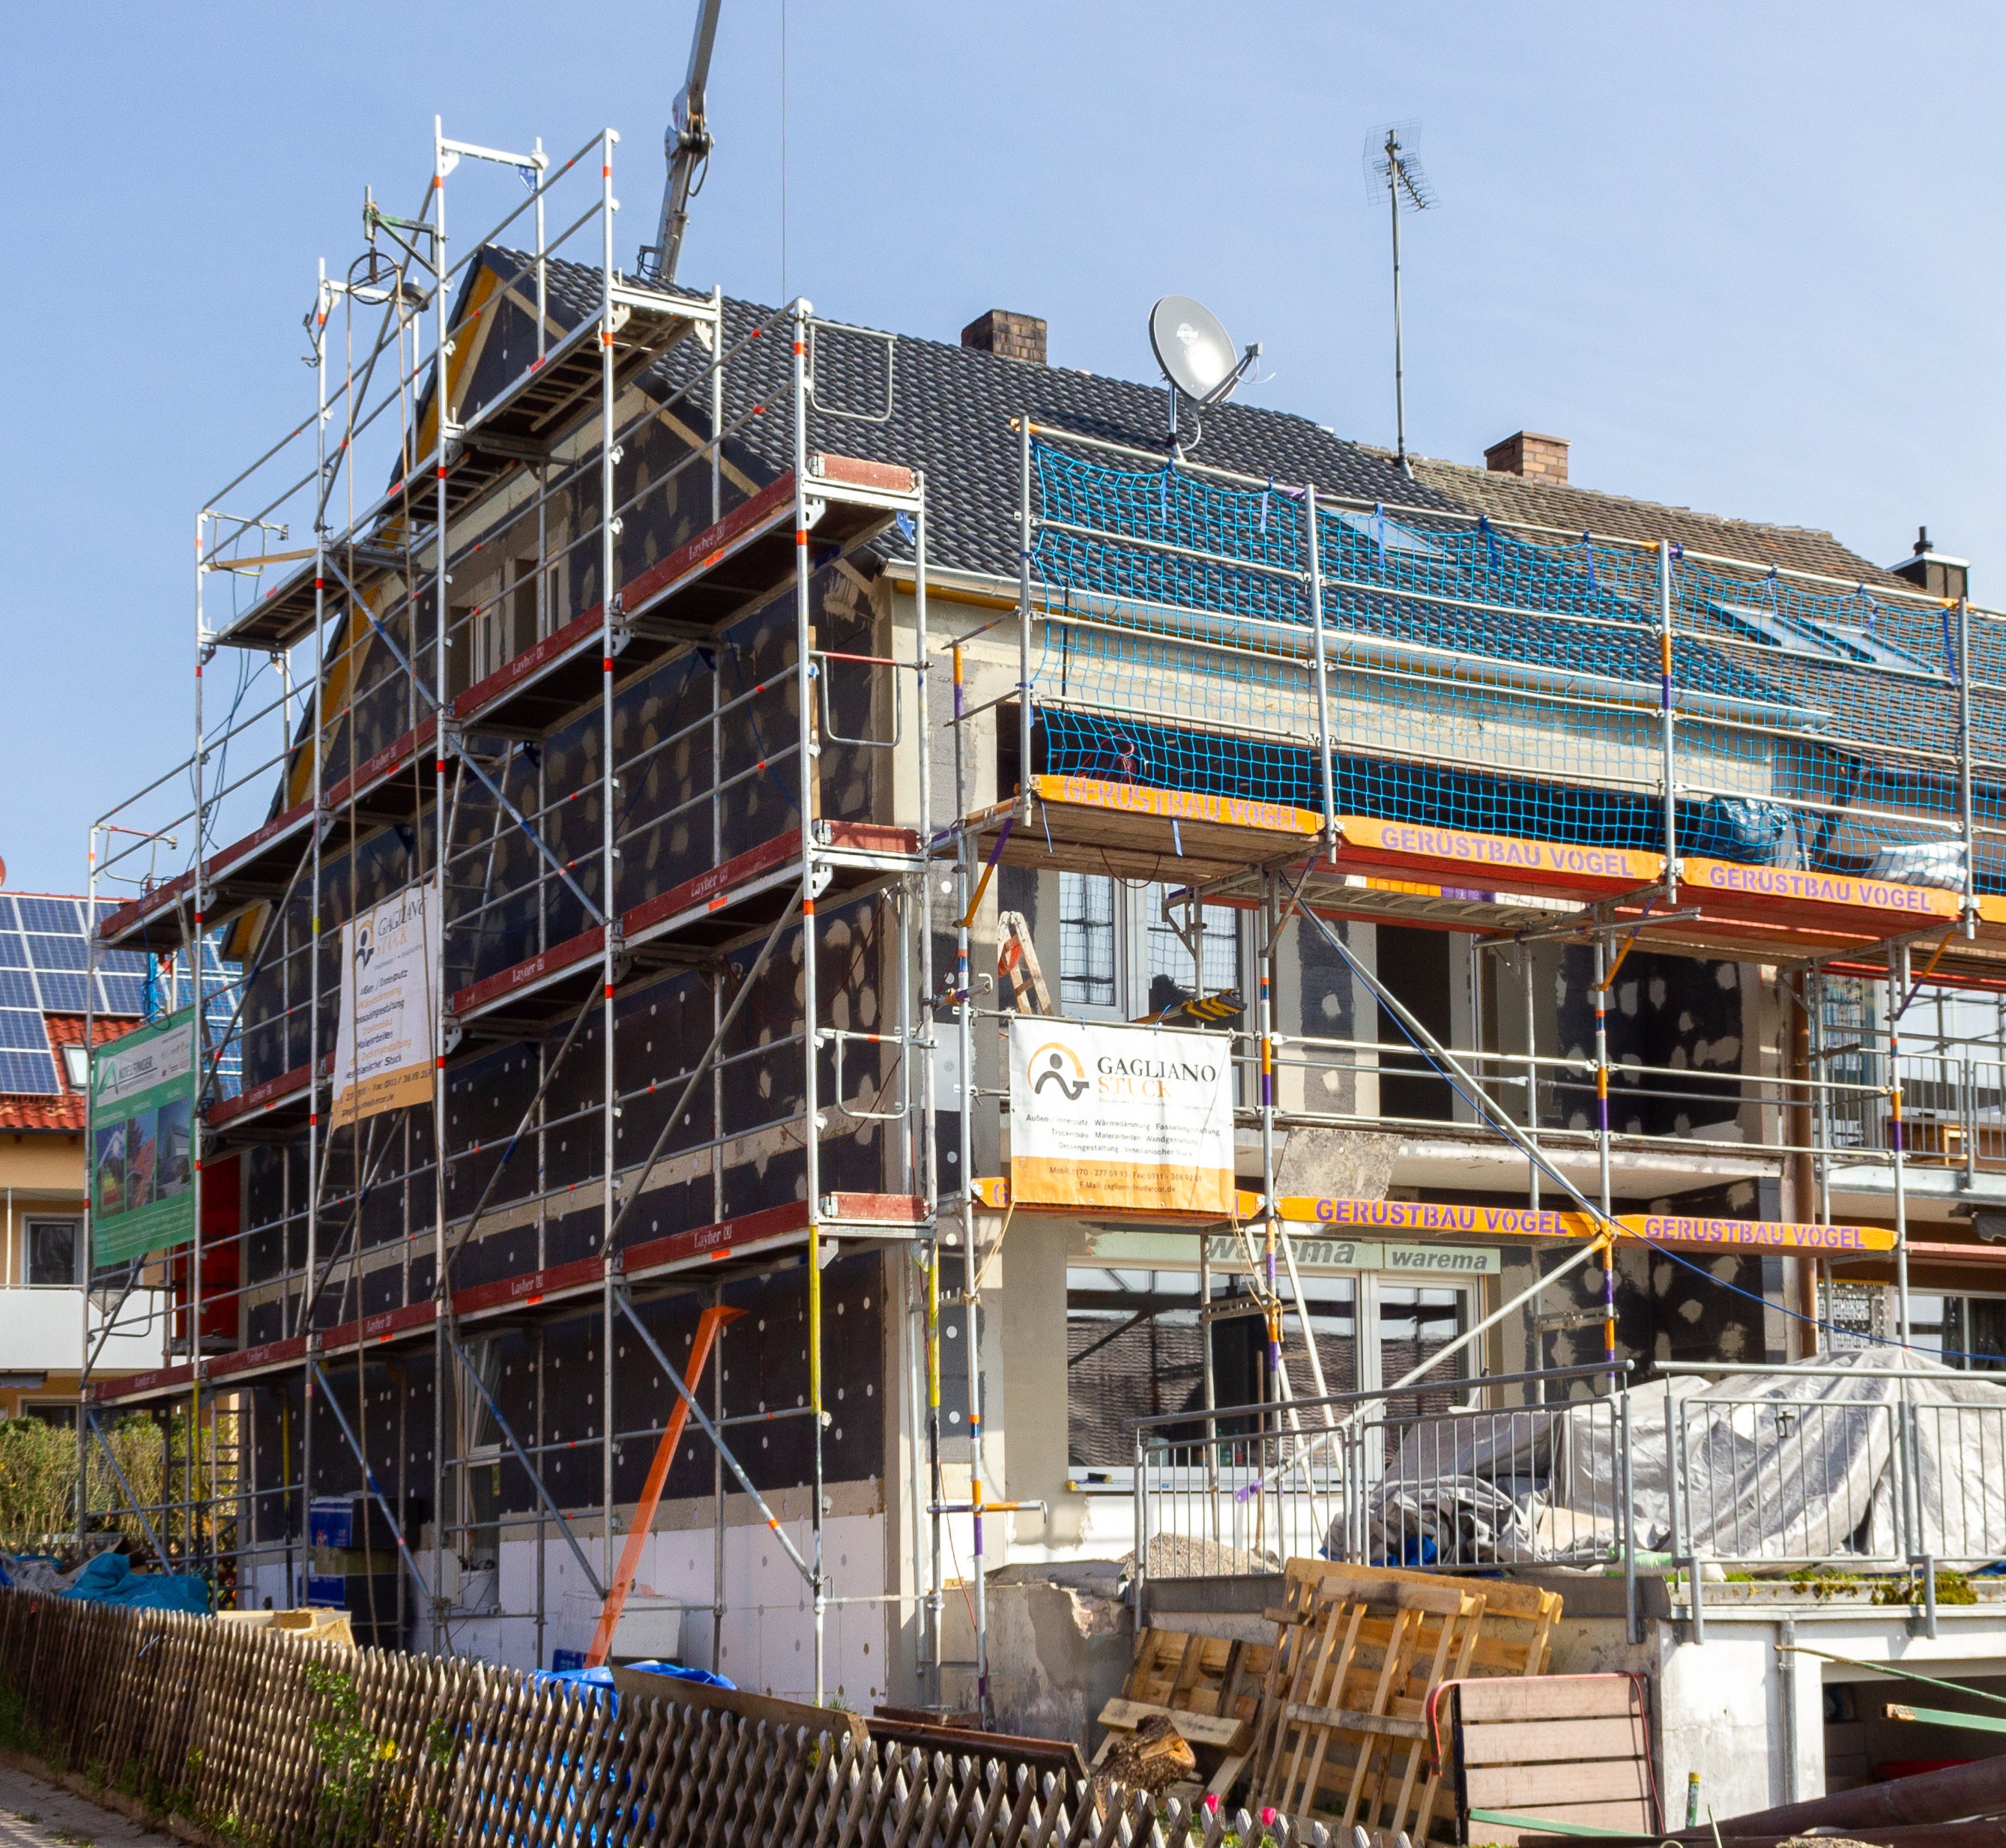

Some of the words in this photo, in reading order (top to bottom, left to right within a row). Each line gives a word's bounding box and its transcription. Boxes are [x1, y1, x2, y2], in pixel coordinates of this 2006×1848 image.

[1228, 799, 1304, 832] VOGEL
[1380, 827, 1541, 866] GERÜSTBAU
[1549, 847, 1634, 877] VOGEL
[1709, 866, 1850, 901] GERÜSTBAU
[1858, 884, 1932, 912] VOGEL
[1097, 1056, 1216, 1083] GAGLIANO
[1098, 1075, 1171, 1098] STUCK
[1484, 1209, 1568, 1235] VOGEL
[694, 1230, 722, 1248] Layher
[1792, 1225, 1865, 1248] VOGEL
[1392, 1251, 1487, 1270] warema
